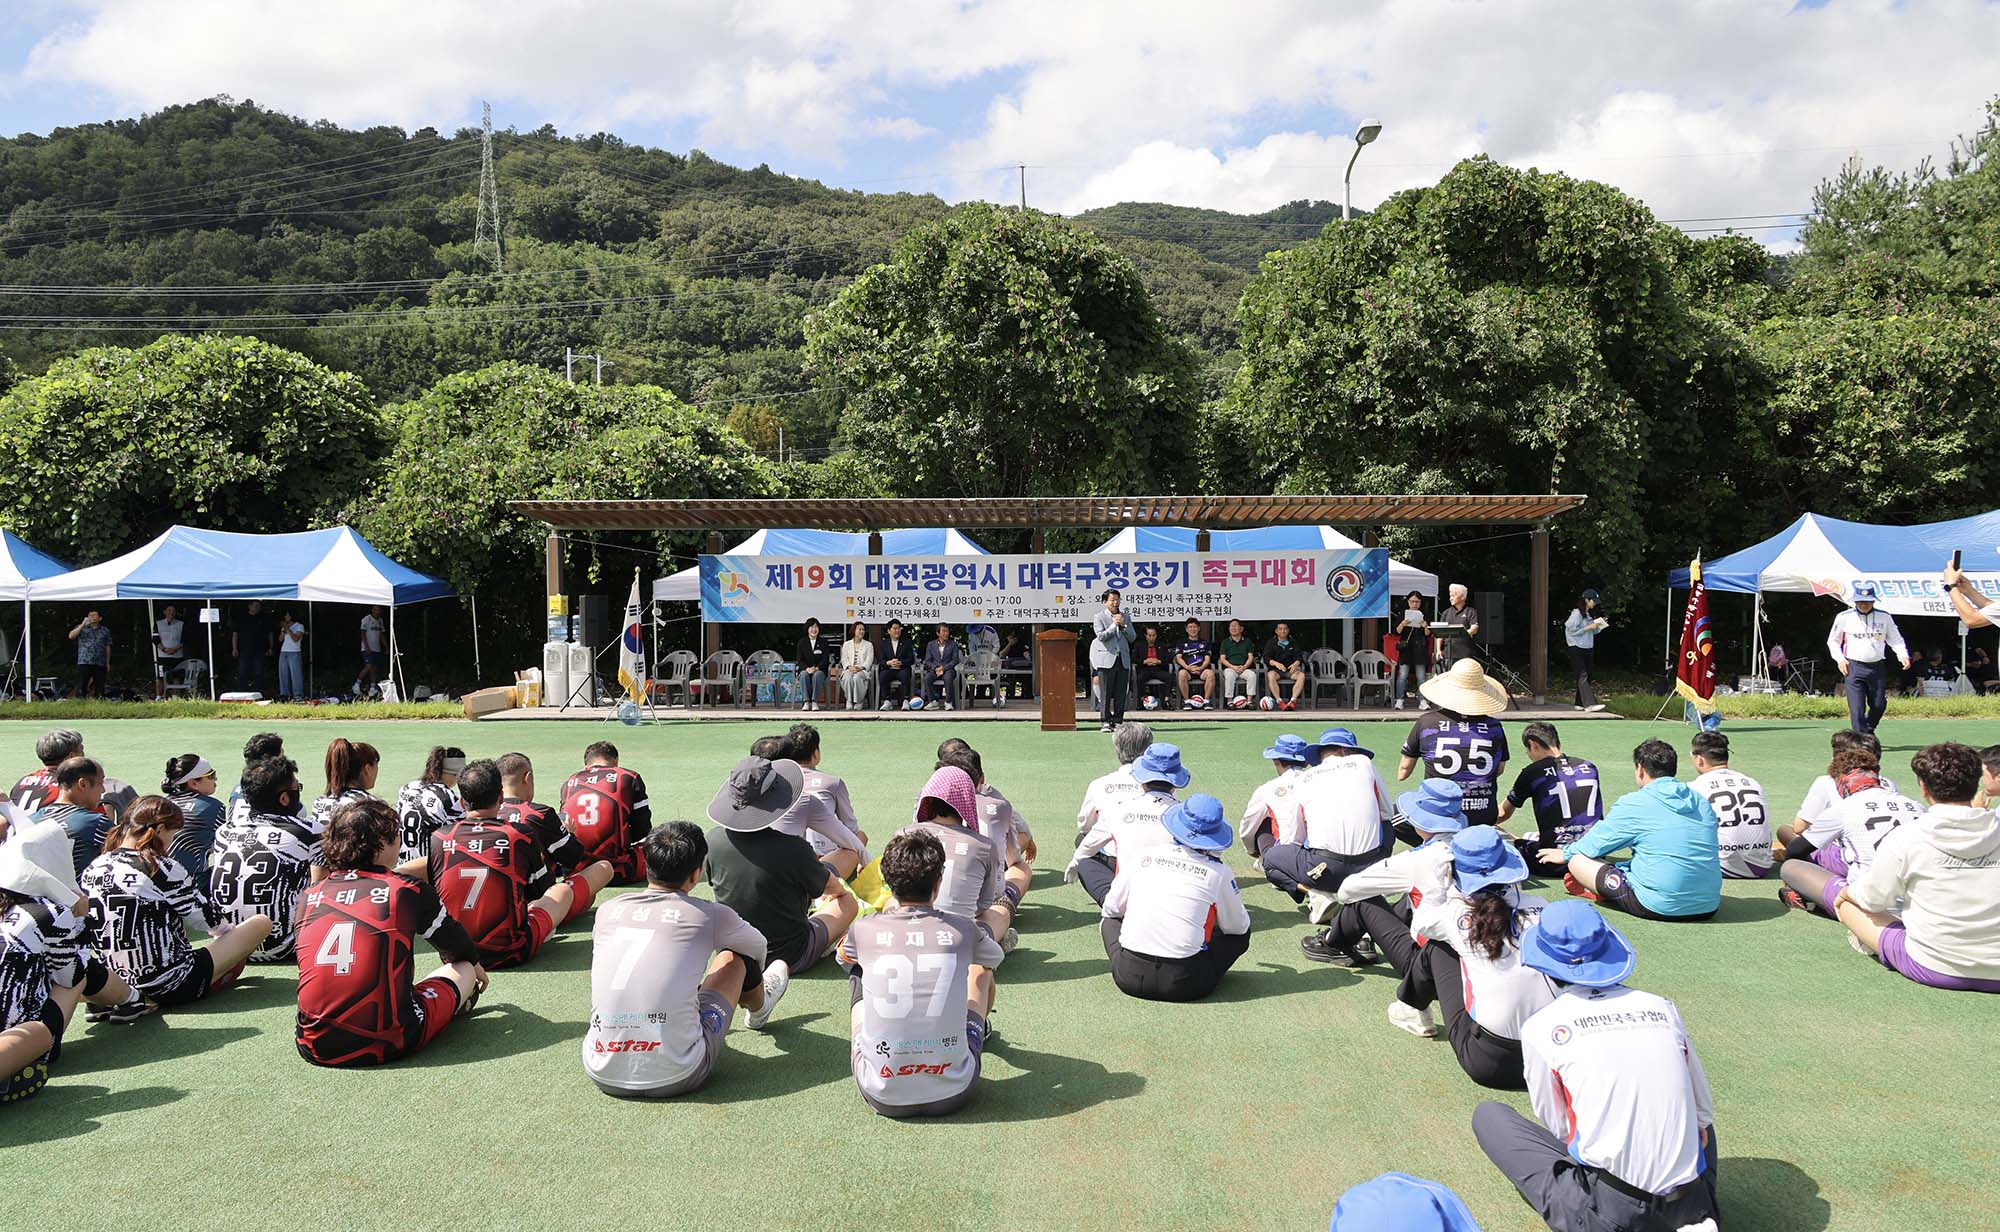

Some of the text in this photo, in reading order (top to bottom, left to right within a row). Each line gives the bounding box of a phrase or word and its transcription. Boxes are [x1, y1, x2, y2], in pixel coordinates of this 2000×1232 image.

[765, 563, 854, 592] 제19회
[866, 562, 1006, 591] 대전광역시
[1019, 560, 1190, 591] 대덕구청장기
[1202, 558, 1316, 587] 족구대회
[857, 596, 875, 606] 일시
[955, 596, 982, 606] 08:00
[995, 596, 1022, 605] 17:00
[857, 609, 876, 619] 주최
[885, 609, 940, 619] 대덕구체육회
[986, 609, 1004, 618] 주관
[1014, 608, 1079, 619] 대덕구족구협회
[1067, 595, 1086, 604] 장소
[1126, 593, 1232, 604] 대전광역시 족구전용구장
[1433, 736, 1494, 776] 55
[577, 793, 600, 826] 3
[1548, 779, 1598, 819] 17
[403, 810, 421, 848] 8
[211, 851, 280, 906] 32
[459, 867, 489, 911] 7
[306, 887, 390, 908] 박태영
[315, 920, 357, 976] 4
[610, 926, 656, 991] 7
[871, 952, 957, 1020] 37
[1573, 1010, 1669, 1029] 대한민국족구협회
[607, 1039, 662, 1053] star
[896, 1062, 953, 1077] star
